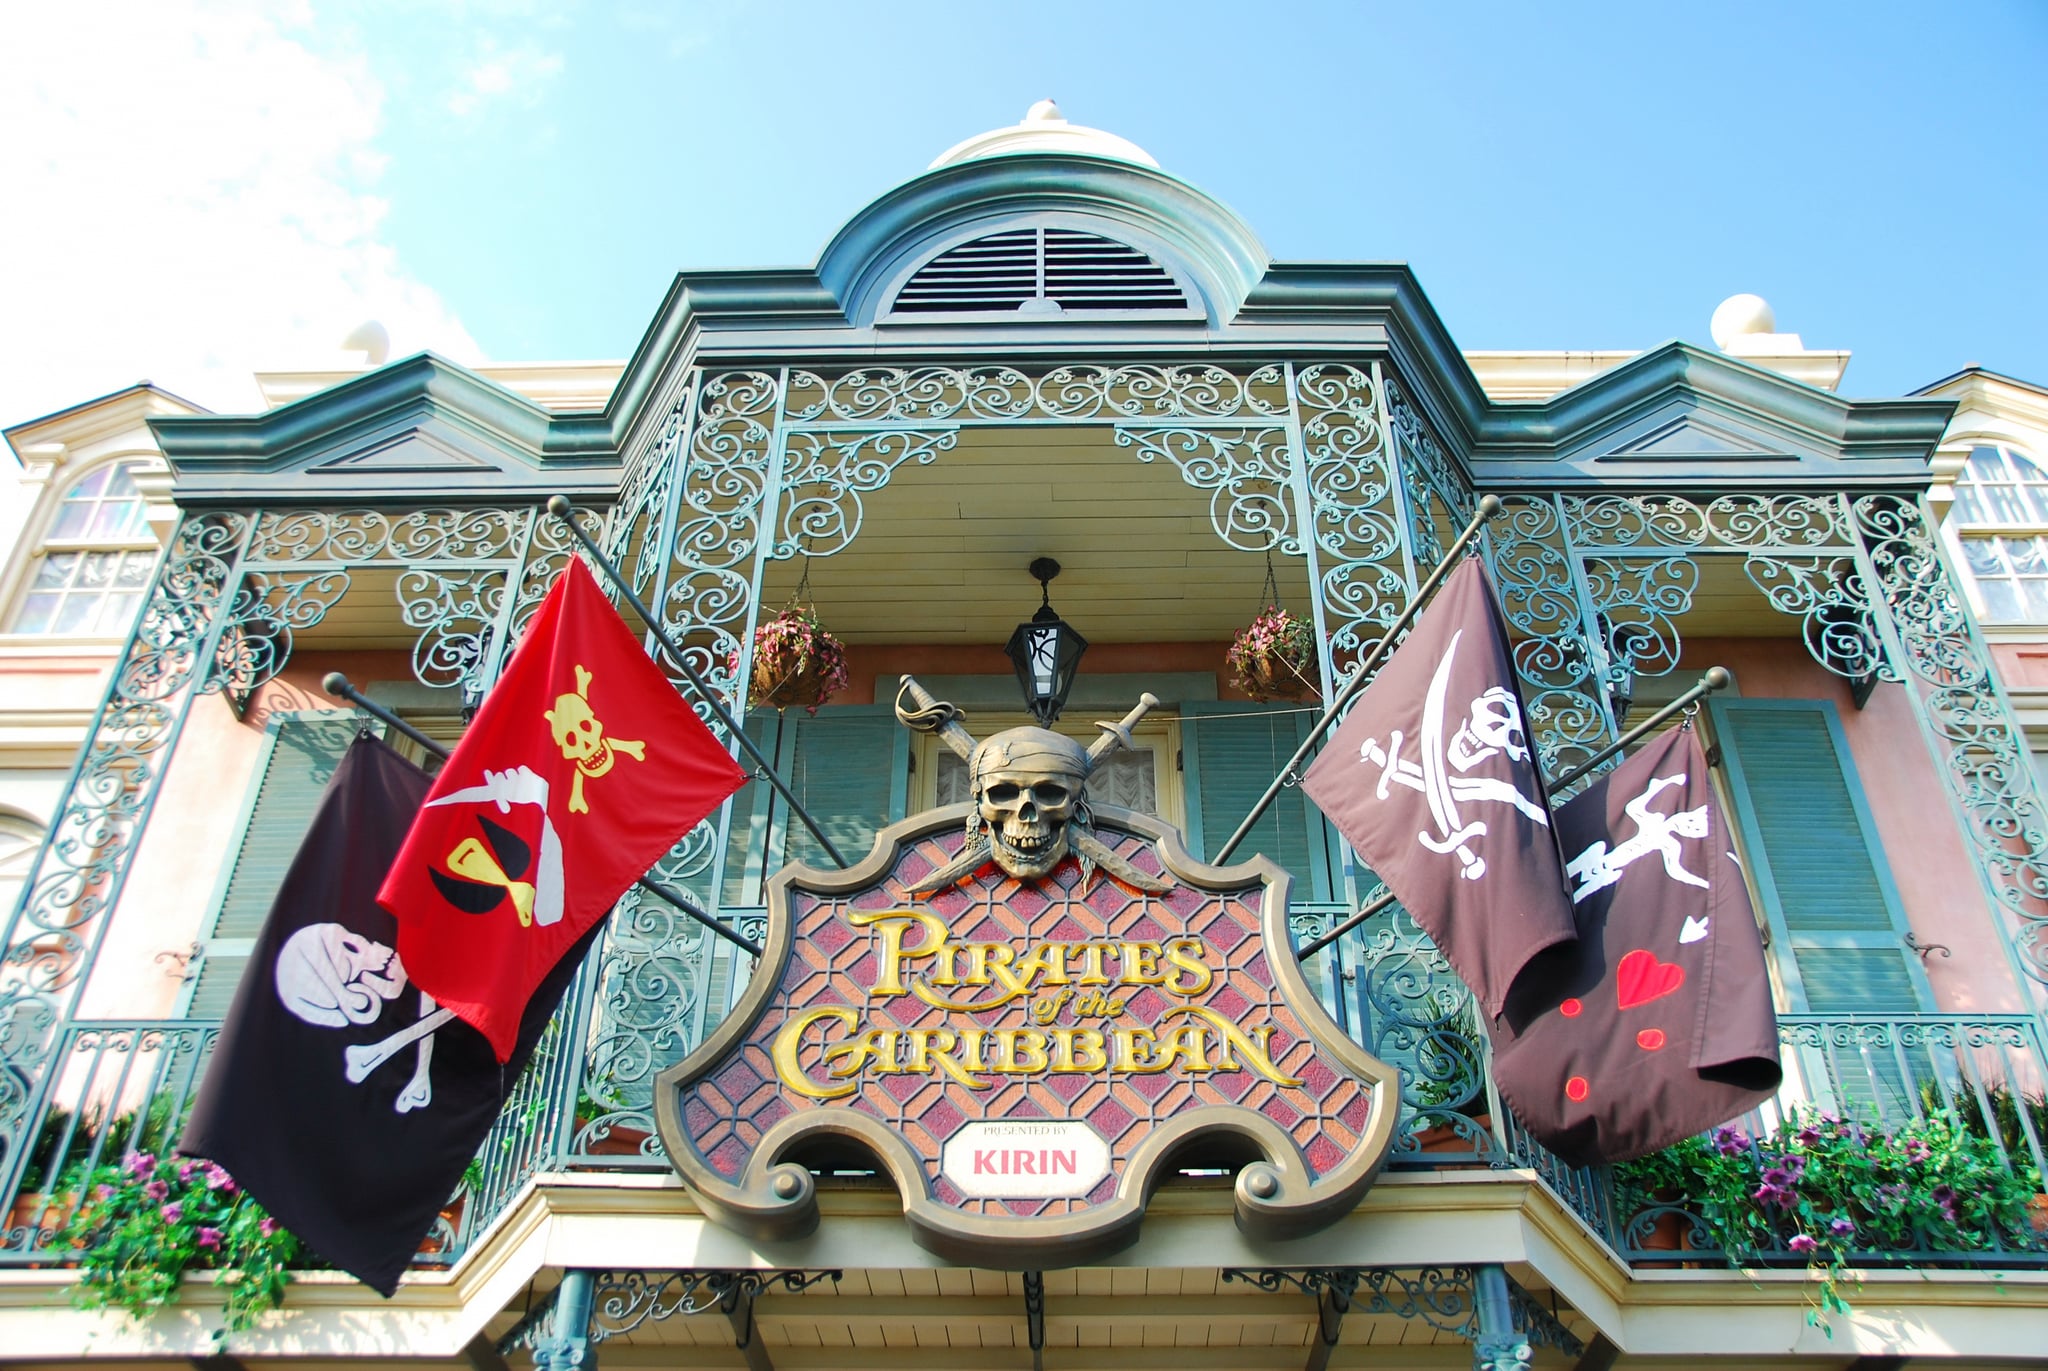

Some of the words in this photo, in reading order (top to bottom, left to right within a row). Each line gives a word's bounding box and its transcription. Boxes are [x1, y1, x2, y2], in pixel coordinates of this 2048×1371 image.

[847, 909, 1213, 1013] PIRATES
[1031, 989, 1073, 1025] of
[1075, 990, 1125, 1017] the
[770, 1004, 1305, 1099] CARIBBEAN
[983, 1126, 1050, 1136] PRESENTED
[1053, 1126, 1069, 1136] BY
[973, 1149, 1077, 1175] KIRIN
